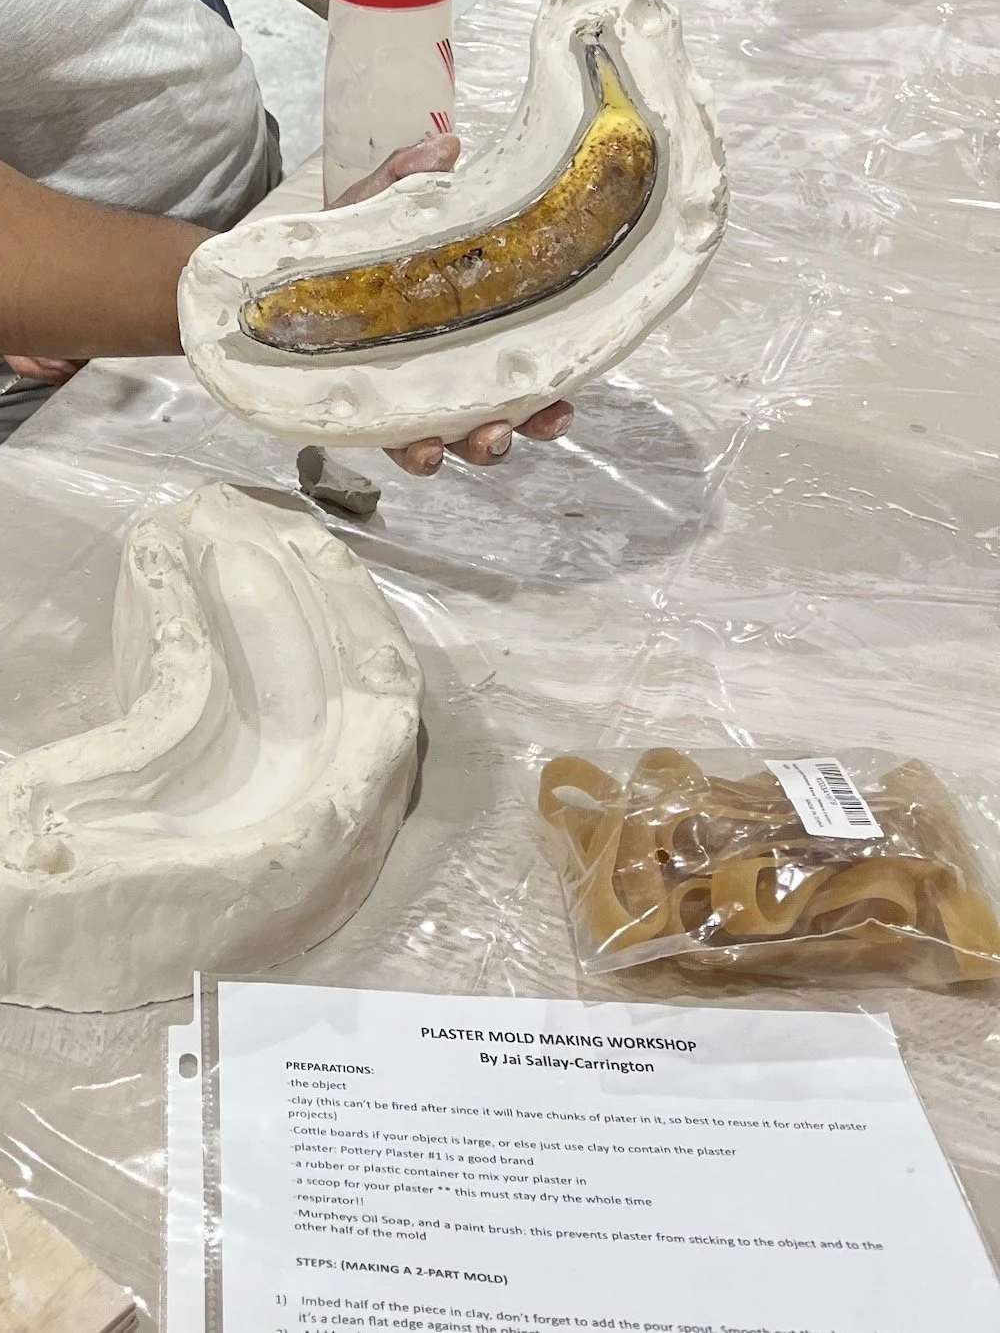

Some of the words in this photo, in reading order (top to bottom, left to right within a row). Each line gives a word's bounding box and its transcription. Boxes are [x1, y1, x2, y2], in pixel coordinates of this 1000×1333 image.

[421, 1027, 485, 1042] PLASTER
[488, 1031, 535, 1044] MOLD
[539, 1033, 604, 1048] MAKING
[606, 1036, 697, 1053] WORKSHOP
[285, 1061, 374, 1075] PREPARATIONS:
[479, 1052, 498, 1067] By
[502, 1053, 522, 1066] Jai
[525, 1055, 655, 1074] Sallay-Carrington
[312, 1080, 347, 1091] object
[288, 1109, 338, 1122] projects)
[316, 1097, 341, 1108] (this
[374, 1100, 389, 1110] be
[391, 1101, 418, 1112] fired
[421, 1103, 448, 1113] after
[450, 1106, 479, 1116] since
[482, 1107, 491, 1116] it
[492, 1108, 513, 1118] will
[516, 1109, 543, 1119] have
[546, 1111, 586, 1121] chunks
[588, 1113, 601, 1122] of
[604, 1114, 638, 1124] plater
[640, 1115, 652, 1124] in
[653, 1115, 666, 1125] it,
[668, 1117, 682, 1125] so
[684, 1115, 710, 1126] best
[712, 1118, 725, 1126] to
[727, 1120, 760, 1128] reuse
[761, 1119, 772, 1129] it
[773, 1119, 790, 1129] for
[793, 1120, 825, 1130] other
[828, 1121, 867, 1132] plaster
[330, 1128, 369, 1139] boards
[372, 1130, 380, 1139] if
[382, 1133, 409, 1142] your
[411, 1133, 448, 1145] object
[450, 1136, 460, 1145] is
[463, 1136, 495, 1149] large,
[498, 1140, 511, 1148] or
[514, 1139, 537, 1149] else
[539, 1141, 561, 1152] just
[564, 1144, 584, 1152] use
[587, 1143, 610, 1154] clay
[612, 1144, 625, 1153] to
[628, 1145, 672, 1154] contain
[673, 1145, 694, 1155] the
[696, 1146, 737, 1157] plaster
[340, 1145, 382, 1158] Pottery
[385, 1147, 425, 1159] Plaster
[445, 1152, 455, 1162] is
[467, 1155, 497, 1165] good
[499, 1155, 534, 1166] brand
[305, 1160, 345, 1171] rubber
[347, 1164, 360, 1172] or
[363, 1163, 401, 1175] plastic
[403, 1168, 460, 1179] container
[462, 1171, 475, 1180] to
[478, 1172, 500, 1181] mix
[502, 1174, 530, 1184] your
[532, 1174, 573, 1185] plaster
[575, 1176, 587, 1186] in
[305, 1178, 341, 1189] scoop
[344, 1178, 361, 1189] for
[363, 1182, 391, 1192] your
[393, 1182, 434, 1194] plaster
[454, 1187, 477, 1198] this
[480, 1191, 510, 1200] must
[513, 1192, 537, 1202] stay
[539, 1192, 559, 1204] dry
[562, 1193, 583, 1204] the
[585, 1194, 622, 1205] whole
[624, 1196, 652, 1207] time
[294, 1222, 328, 1232] other
[330, 1224, 354, 1235] half
[356, 1226, 370, 1236] of
[372, 1228, 393, 1239] the
[396, 1231, 427, 1241] mold
[361, 1214, 378, 1224] Oil
[381, 1215, 415, 1227] Soap,
[418, 1218, 440, 1229] and
[444, 1222, 451, 1230] a
[454, 1223, 485, 1233] paint
[488, 1224, 527, 1236] brush:
[529, 1226, 553, 1237] this
[555, 1230, 609, 1240] prevents
[611, 1231, 653, 1242] plaster
[655, 1232, 686, 1244] from
[688, 1235, 736, 1248] sticking
[737, 1237, 751, 1247] to
[753, 1237, 775, 1247] the
[777, 1238, 817, 1250] object
[820, 1239, 843, 1249] and
[845, 1241, 860, 1250] to
[861, 1241, 884, 1251] the
[296, 1257, 337, 1269] STEPS:
[340, 1259, 400, 1274] (MAKING
[403, 1266, 412, 1275] A
[415, 1267, 461, 1280] 2-PART
[463, 1271, 508, 1286] MOLD)
[275, 1294, 287, 1307] 1)
[301, 1295, 341, 1308] Imbed
[344, 1298, 369, 1310] half
[372, 1300, 386, 1311] of
[388, 1301, 409, 1313] the
[412, 1304, 447, 1316] piece
[450, 1306, 462, 1317] in
[465, 1308, 493, 1321] clay,
[533, 1313, 572, 1327] forget
[574, 1317, 588, 1327] to
[591, 1318, 616, 1329] add
[617, 1319, 641, 1330] the
[643, 1323, 674, 1333] pour
